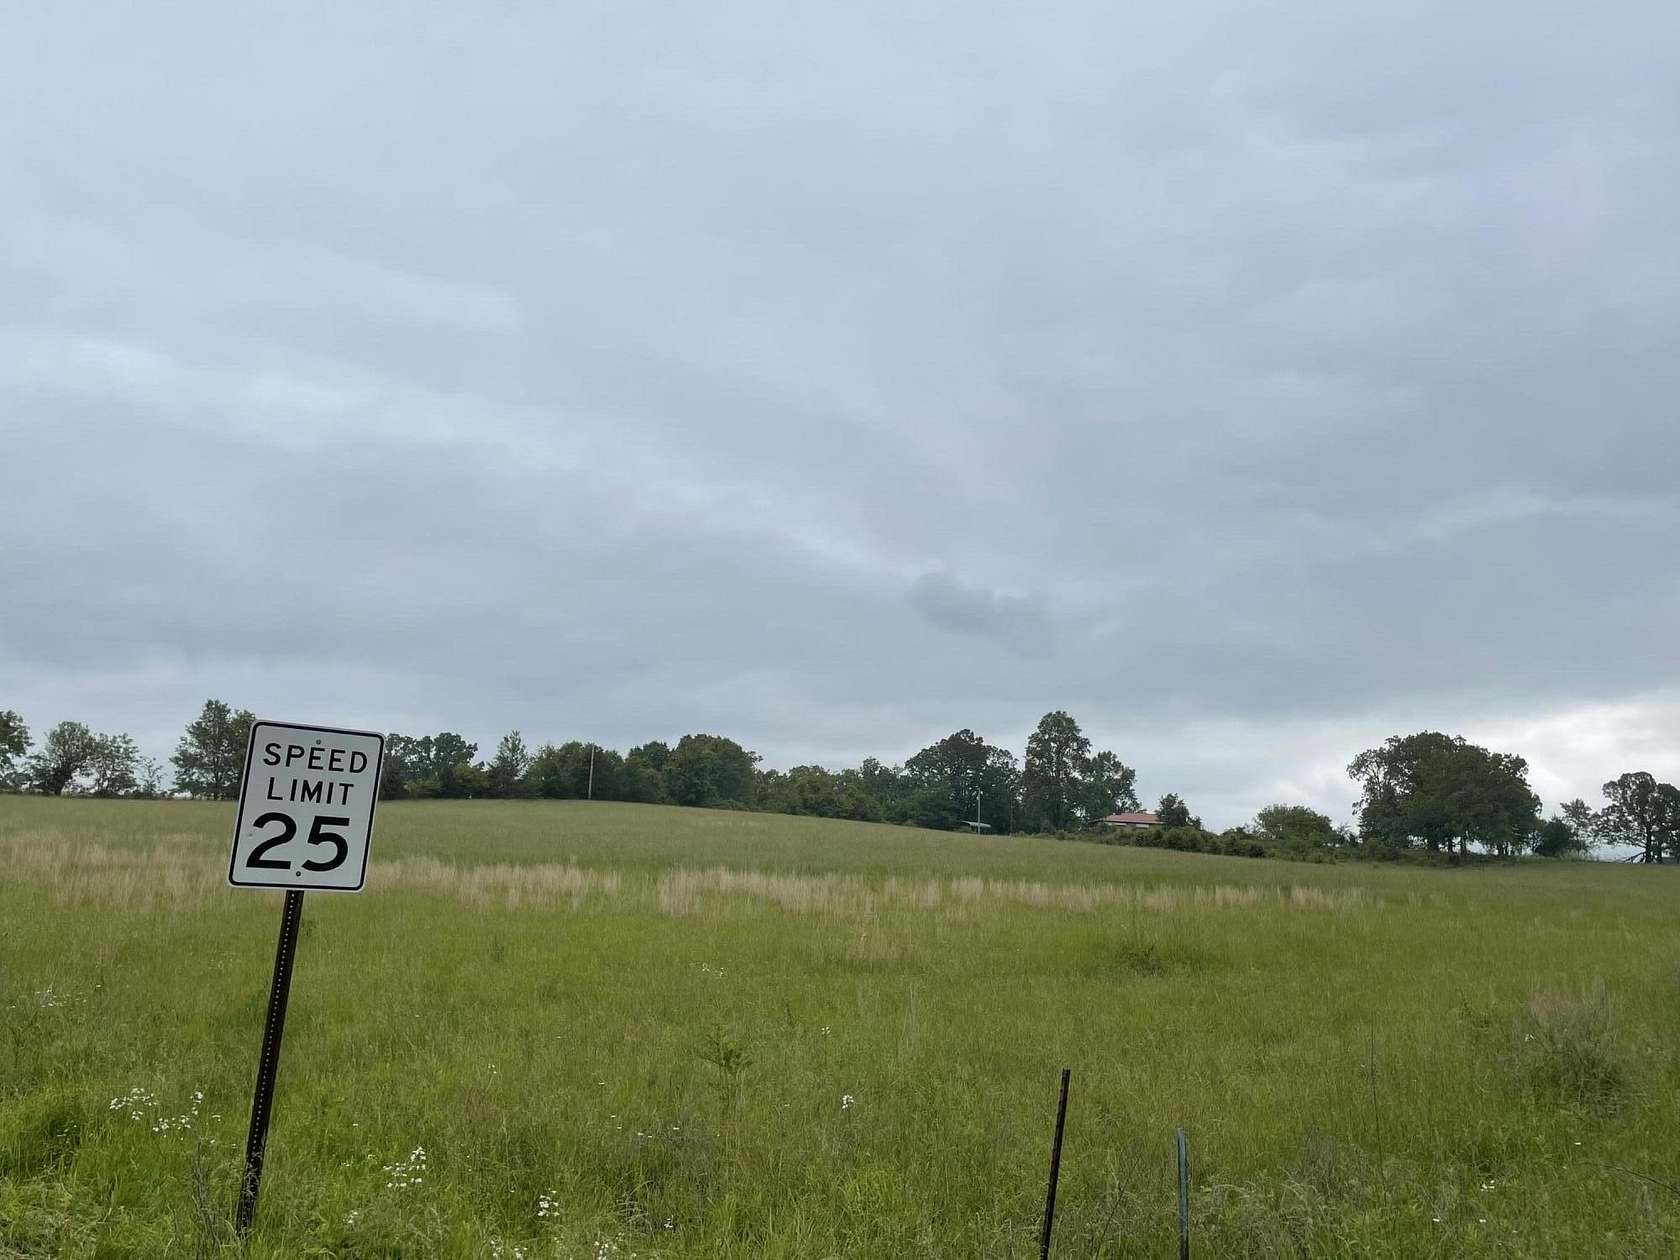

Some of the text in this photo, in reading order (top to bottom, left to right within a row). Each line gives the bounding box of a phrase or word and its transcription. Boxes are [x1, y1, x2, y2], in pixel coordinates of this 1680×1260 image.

[263, 742, 368, 774] SPEED
[267, 776, 355, 806] LIMIT
[246, 811, 350, 872] 25
